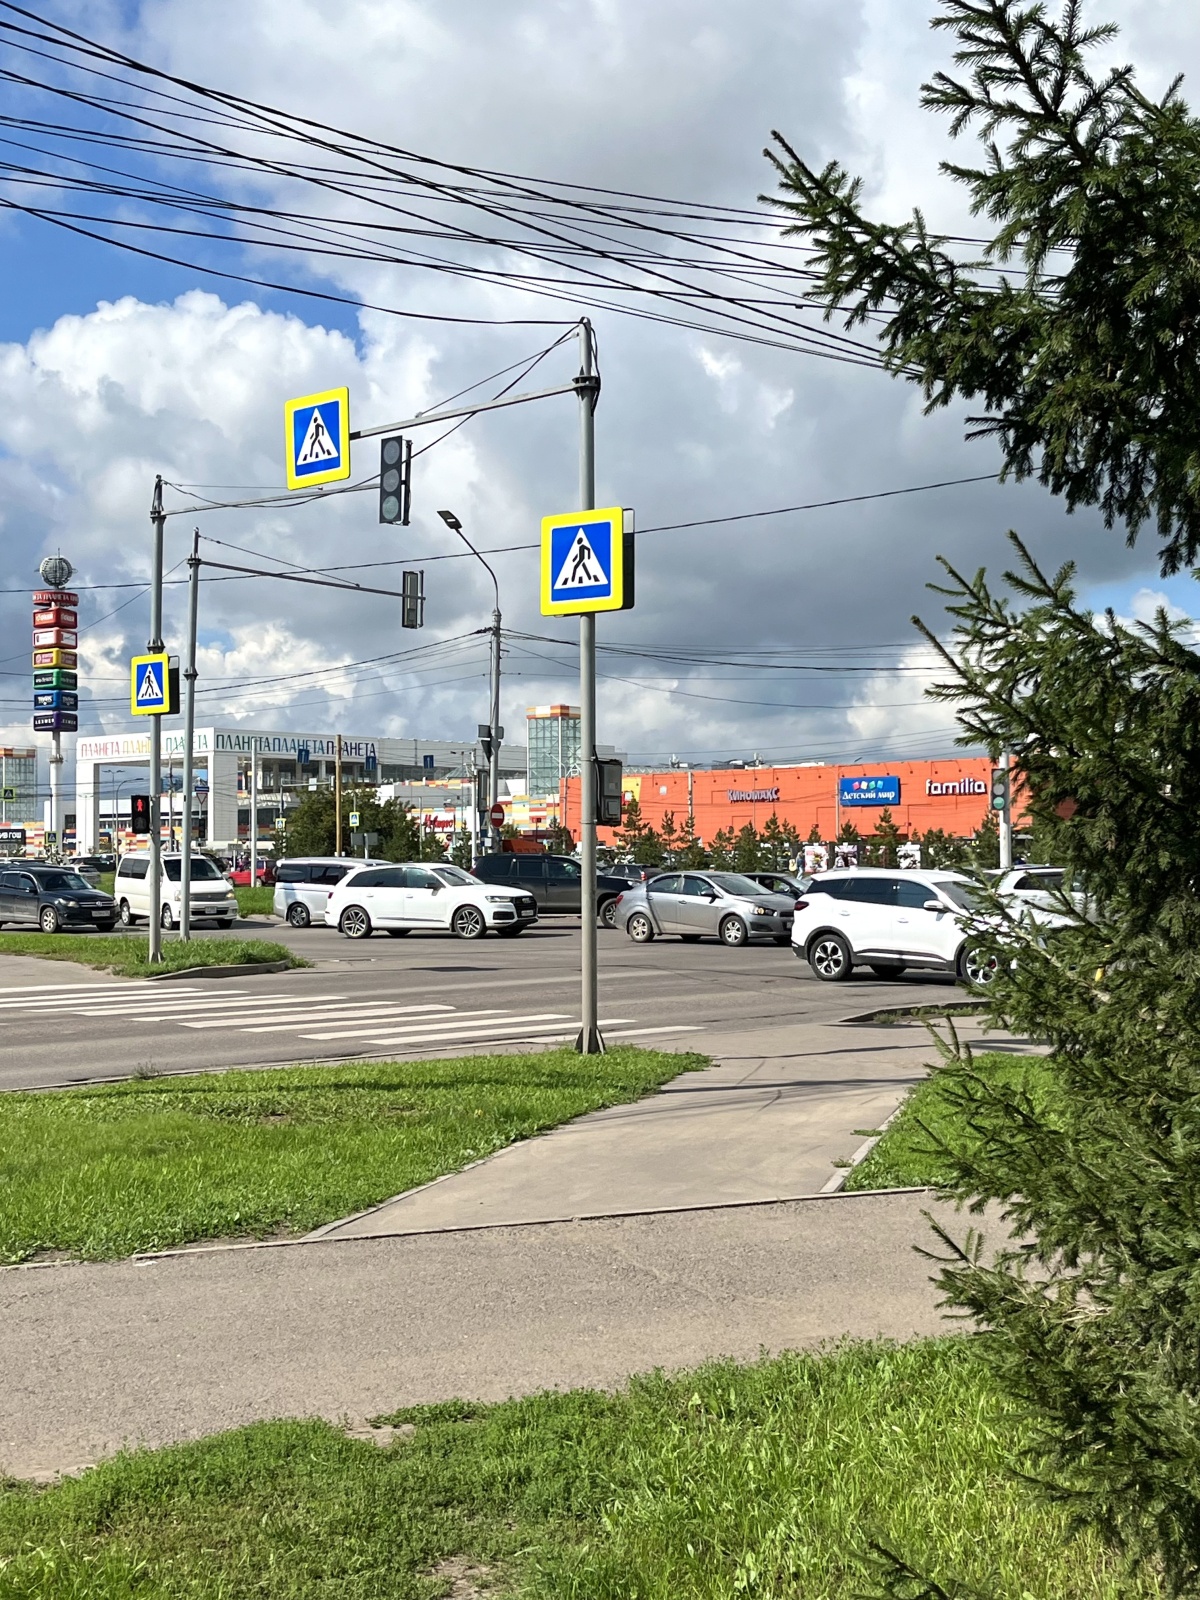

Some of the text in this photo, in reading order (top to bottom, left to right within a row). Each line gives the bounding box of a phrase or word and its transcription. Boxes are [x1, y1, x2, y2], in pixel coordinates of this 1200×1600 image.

[81, 741, 120, 757] ПЛАНЕТА
[272, 737, 324, 754] ПЛАНЕТА
[326, 740, 376, 757] ПАНЕТА
[727, 786, 778, 802] КИНОМАКС
[925, 777, 986, 795] familia
[842, 790, 896, 801] Детский мир
